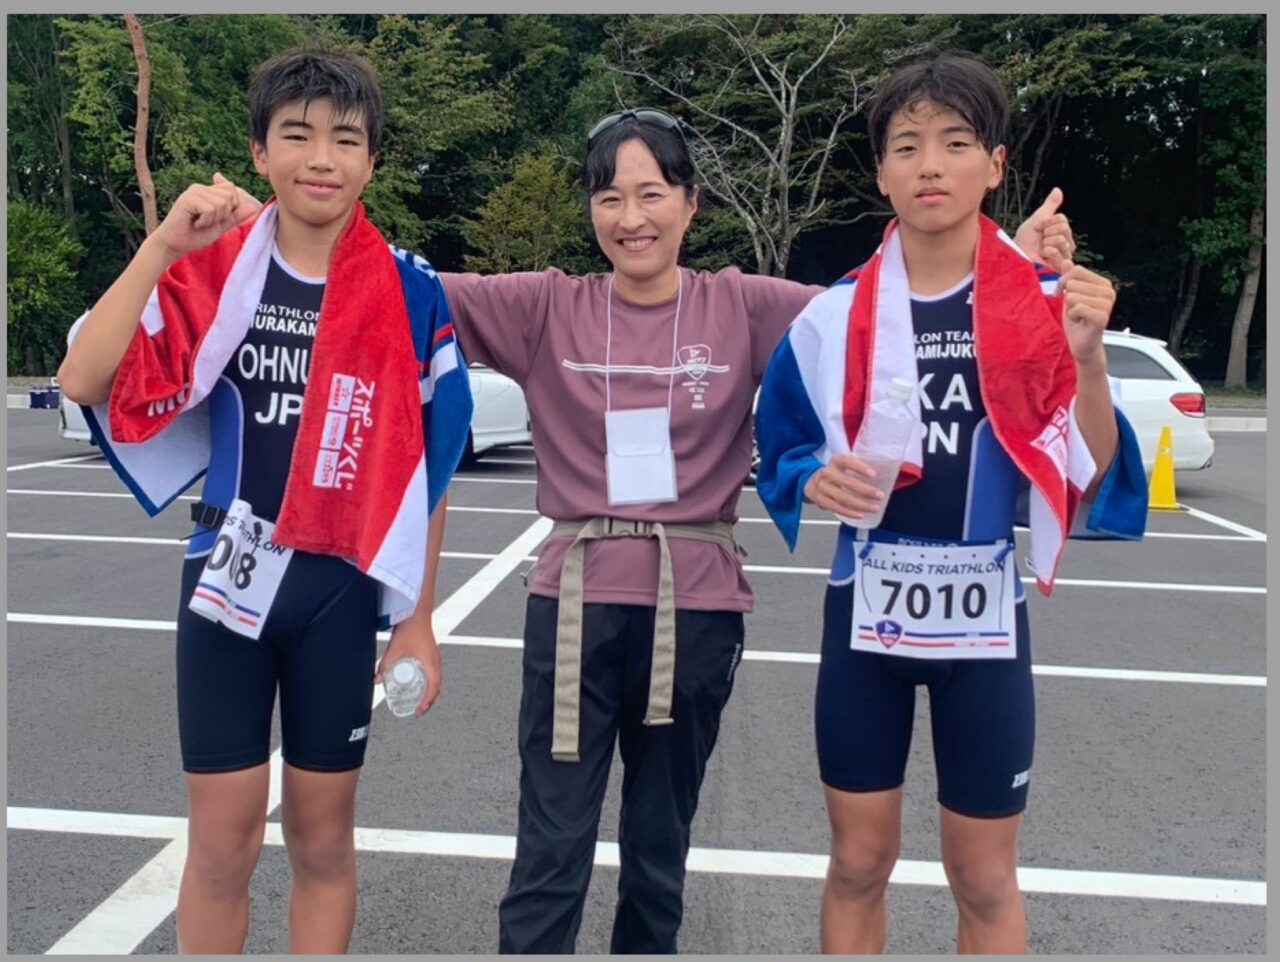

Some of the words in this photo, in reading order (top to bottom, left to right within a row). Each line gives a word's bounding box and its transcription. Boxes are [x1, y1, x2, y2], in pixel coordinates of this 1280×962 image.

[334, 377, 376, 490] スポーツくじ
[863, 558, 887, 570] ALL
[891, 562, 923, 575] KIDS
[881, 579, 988, 620] 7010
